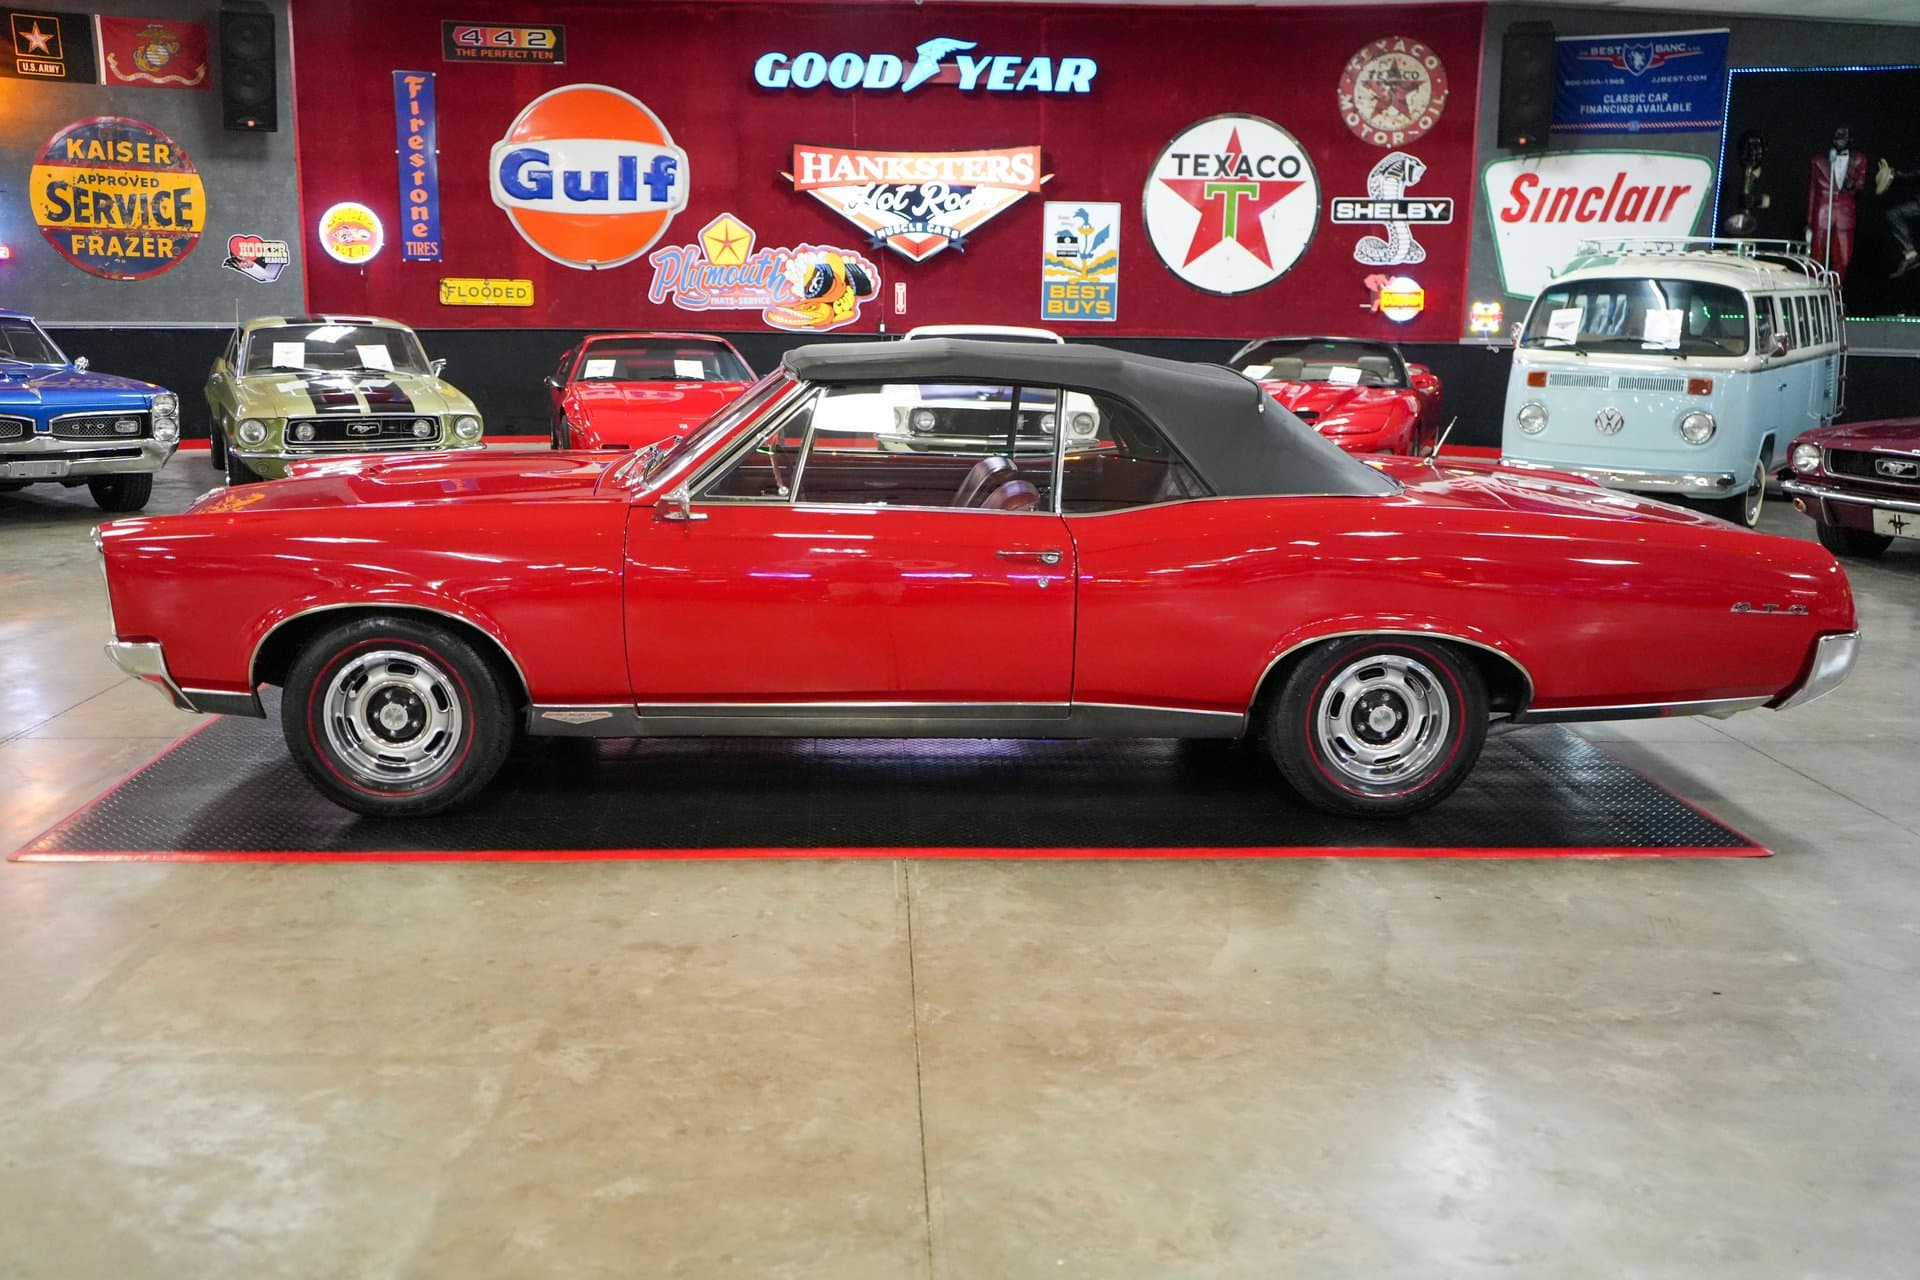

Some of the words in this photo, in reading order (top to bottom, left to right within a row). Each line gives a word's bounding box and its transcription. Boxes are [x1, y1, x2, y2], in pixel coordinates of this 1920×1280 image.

[456, 48, 478, 57] THE
[481, 49, 527, 58] PERFECT
[532, 50, 554, 59] TEN
[1590, 45, 1622, 55] BEST
[1655, 43, 1686, 53] BANC
[38, 65, 60, 74] ARMY
[755, 51, 903, 89] GOOD
[955, 55, 1097, 93] YEAR
[1603, 94, 1646, 103] CLASSIC
[1647, 93, 1669, 102] CAR
[1580, 104, 1634, 114] FINANCING
[1635, 103, 1692, 113] AVAILABLE
[1340, 95, 1405, 144] MOTOR
[1419, 95, 1445, 130] OIL
[66, 138, 172, 165] KAISER
[403, 76, 429, 238] Firestone
[500, 147, 678, 202] Gulf
[800, 151, 1035, 185] HANKSTERS
[1171, 153, 1301, 178] TEXACO
[77, 173, 160, 188] APPROVED
[46, 180, 194, 228] SERVICE
[1501, 172, 1692, 223] Sinclair
[1335, 202, 1447, 220] SHELBY
[876, 222, 923, 239] MUSCLE
[926, 223, 960, 237] CARS
[71, 234, 174, 258] FRAZER
[406, 241, 438, 256] TIRES
[656, 250, 792, 305] Plymouth
[446, 286, 527, 299] FLOODED
[1050, 285, 1110, 300] BEST
[1048, 300, 1111, 315] BUYS
